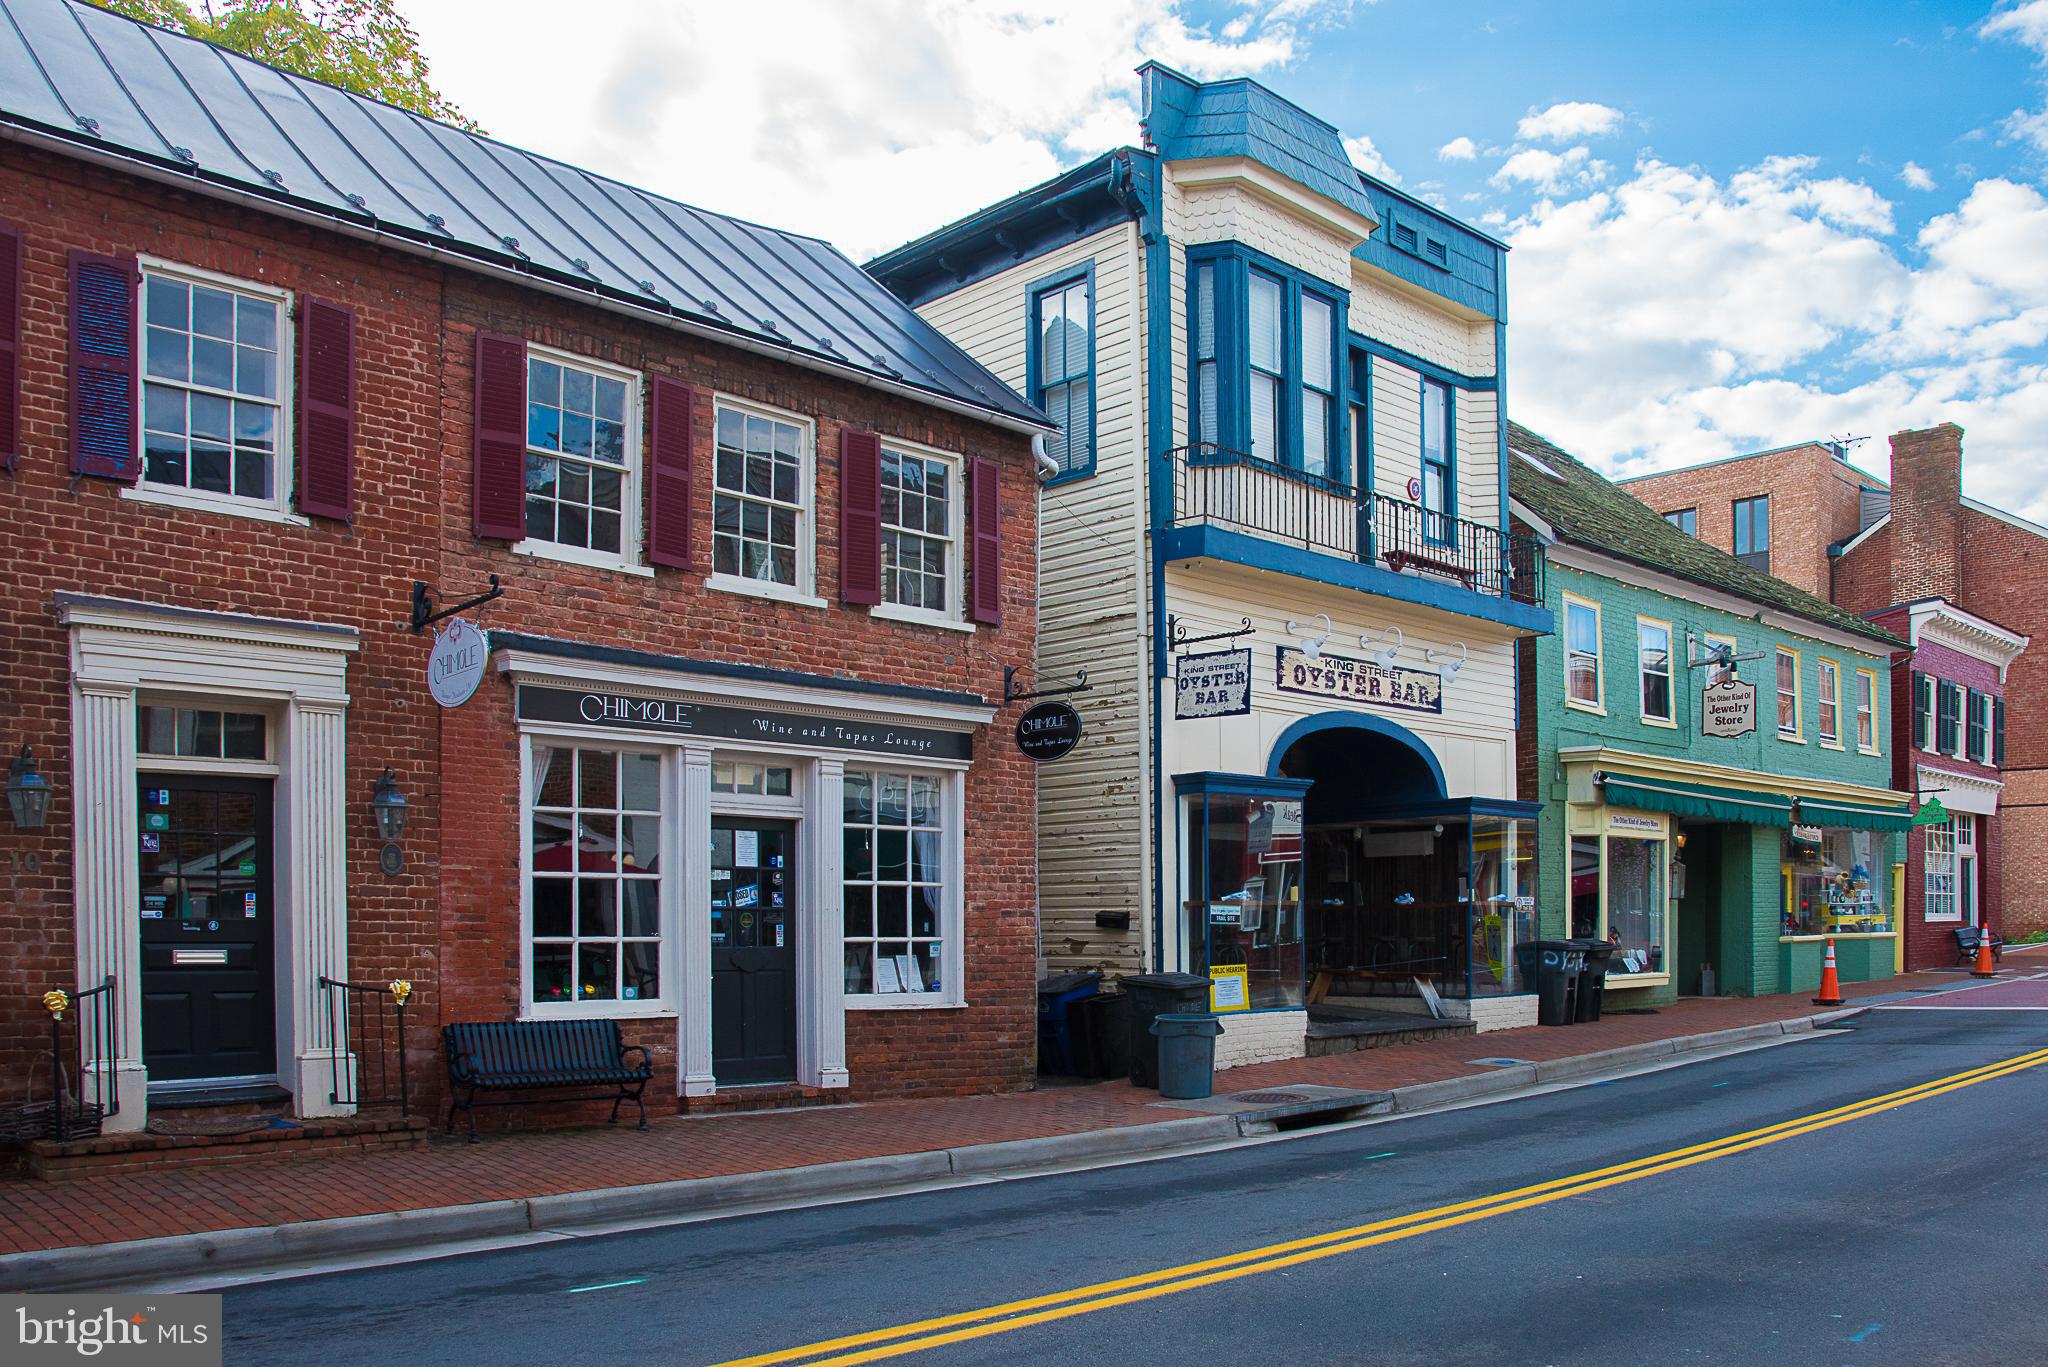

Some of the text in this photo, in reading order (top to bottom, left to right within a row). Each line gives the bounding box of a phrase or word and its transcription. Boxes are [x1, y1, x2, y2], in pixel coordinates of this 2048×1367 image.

[434, 644, 478, 685] CHIMOLE
[1184, 663, 1241, 674] KING STREET
[1324, 658, 1402, 680] KING STREET
[1180, 671, 1245, 690] OYSTER
[1294, 664, 1429, 704] OYSTER BAR
[1195, 690, 1229, 705] BAR
[1717, 694, 1731, 702] Other
[580, 695, 692, 725] CHIMOLE
[1709, 703, 1749, 714] Jewelry
[1022, 715, 1068, 734] CHIMOLE
[1715, 716, 1743, 726] Store
[753, 719, 932, 750] Wine and Tapas Lounge
[1210, 966, 1246, 976] PUBLIC HEARING
